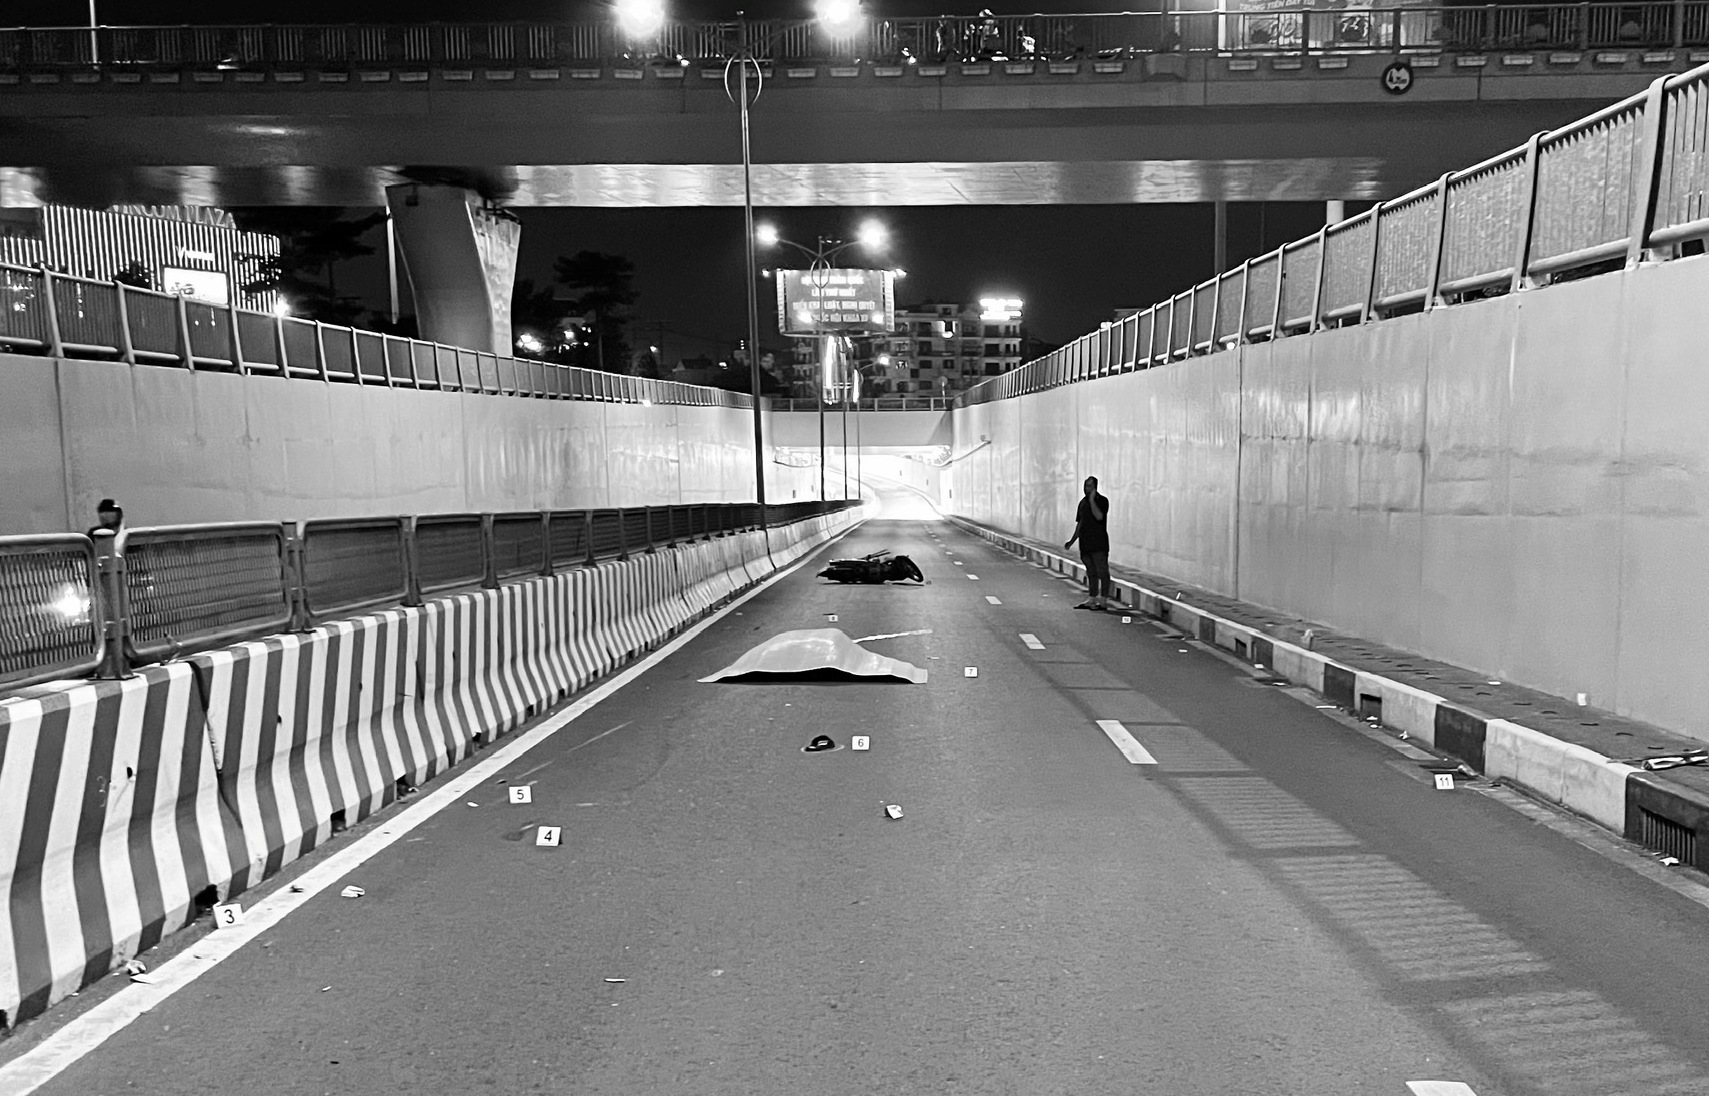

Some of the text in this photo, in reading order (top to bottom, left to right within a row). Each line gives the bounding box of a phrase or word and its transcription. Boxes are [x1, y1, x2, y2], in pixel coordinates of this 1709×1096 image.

[183, 204, 237, 230] PLAZA
[857, 738, 864, 747] 6
[1439, 777, 1450, 787] 11
[516, 789, 525, 800] 5
[544, 830, 552, 842] 4
[224, 909, 235, 924] 3
